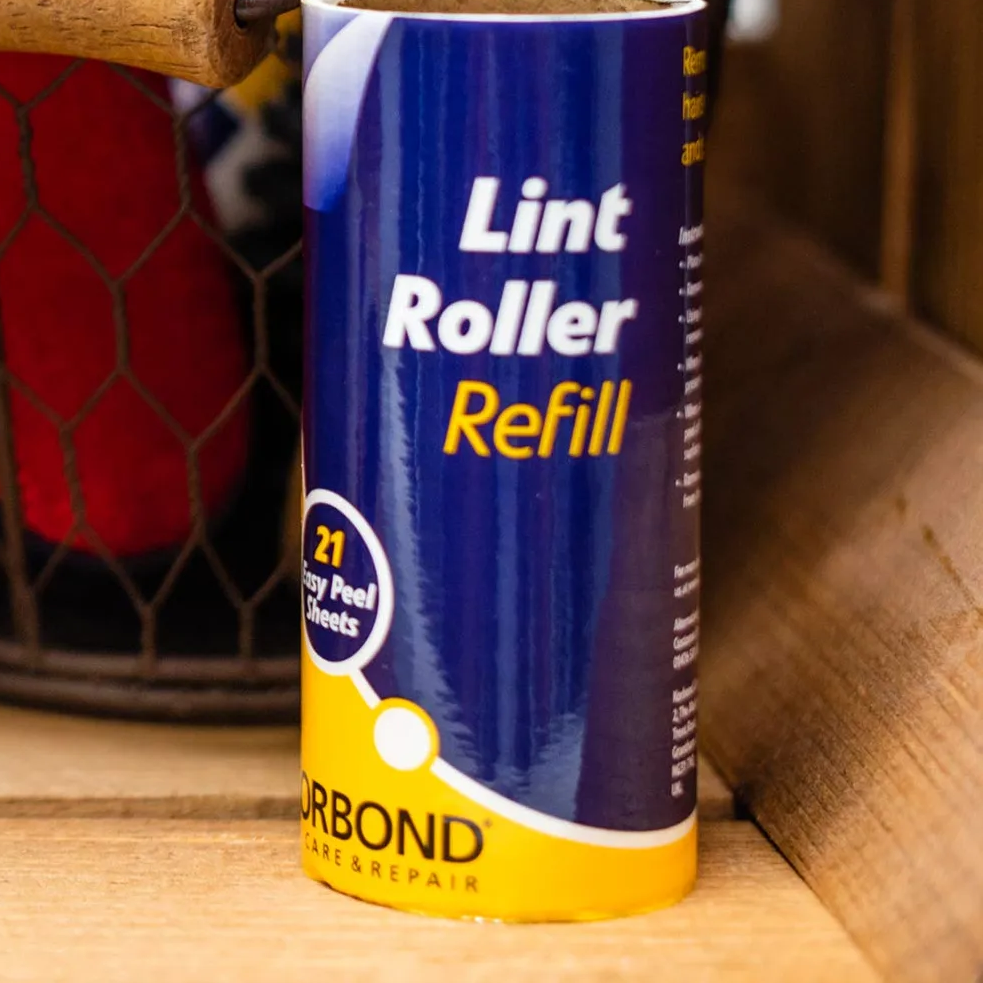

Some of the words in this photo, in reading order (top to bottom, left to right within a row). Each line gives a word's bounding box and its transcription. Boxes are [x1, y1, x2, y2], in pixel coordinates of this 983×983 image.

[458, 176, 633, 254] Lint
[382, 273, 639, 356] Roller
[443, 378, 632, 459] Refill
[313, 524, 346, 568] 21
[306, 594, 360, 638] Sheets
[330, 573, 378, 610] Peel
[301, 770, 484, 864] ORBOND
[305, 832, 342, 866] CARE
[351, 855, 362, 873] &
[371, 860, 479, 893] REPAIR
